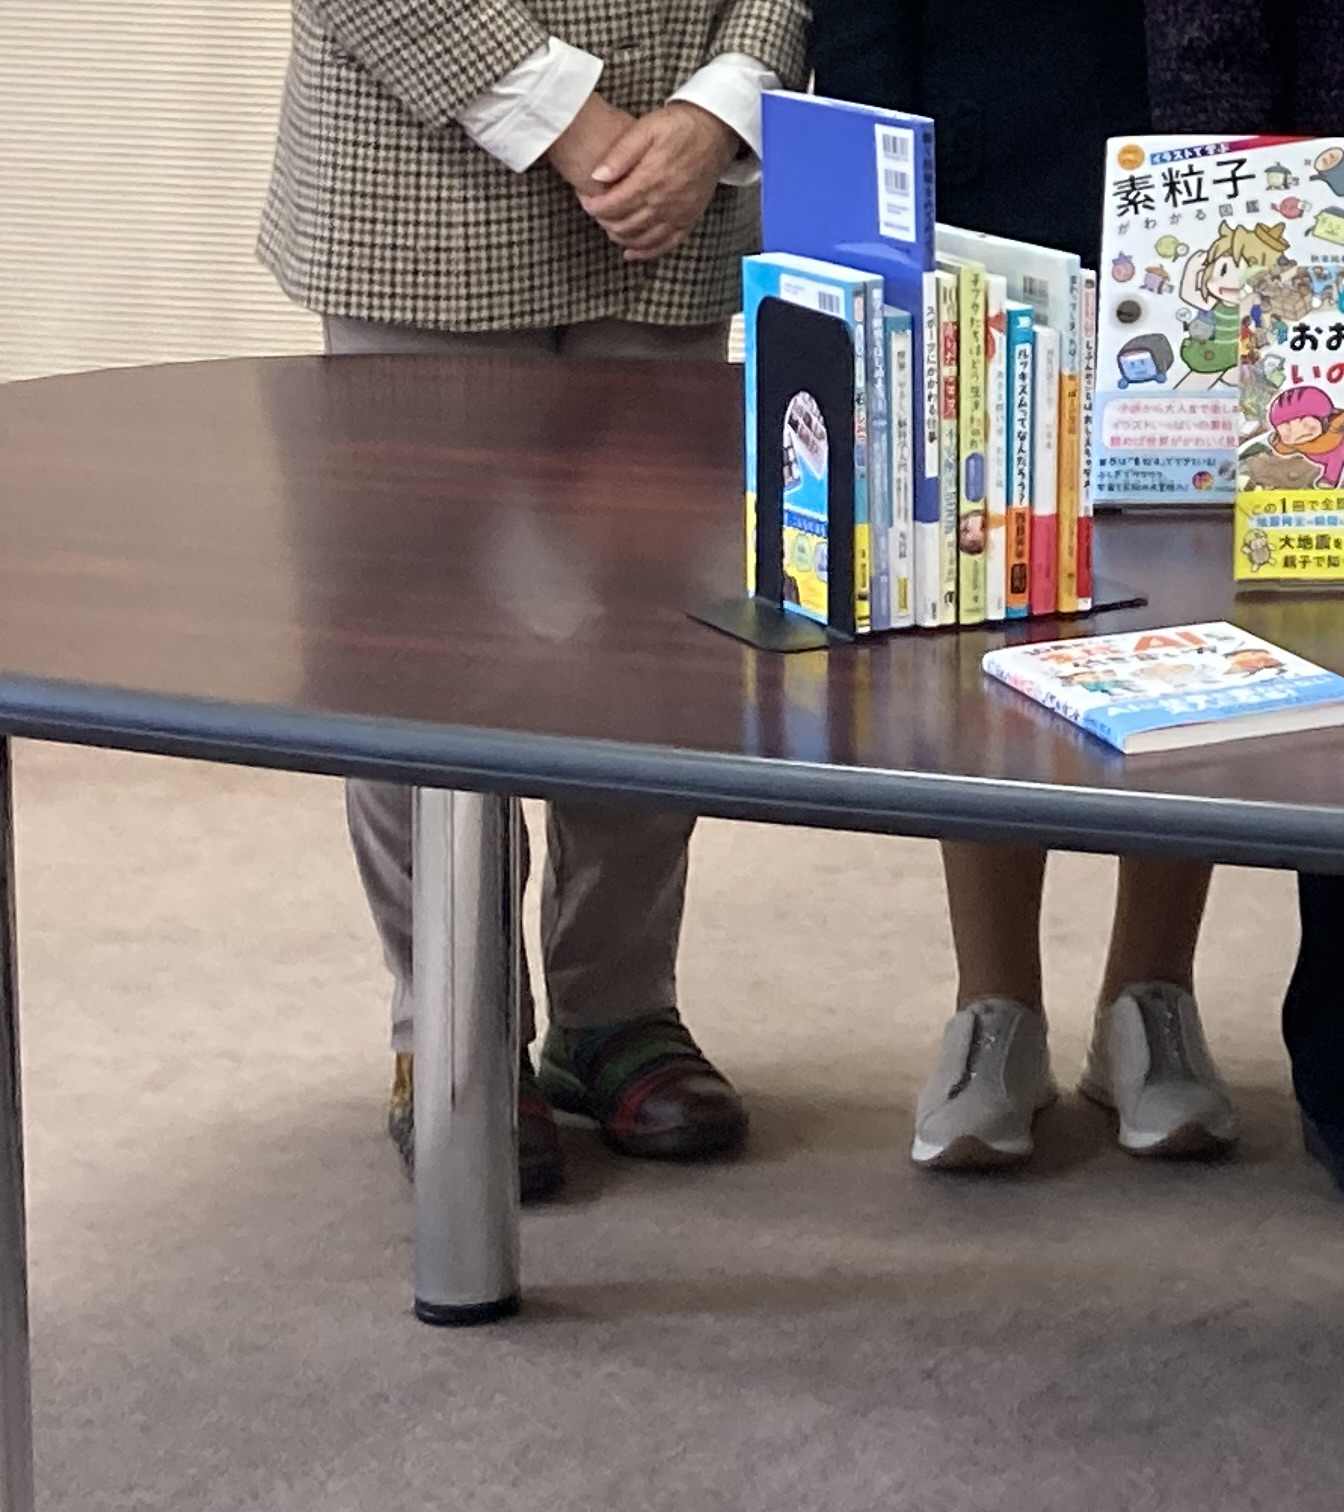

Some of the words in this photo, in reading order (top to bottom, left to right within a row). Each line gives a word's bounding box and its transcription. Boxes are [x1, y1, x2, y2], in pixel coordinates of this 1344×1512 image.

[1151, 144, 1230, 164] イラストで学ぶ
[1113, 158, 1255, 216] 素粒子
[1118, 200, 1259, 234] がわかる図鑑
[1133, 631, 1207, 652] AI
